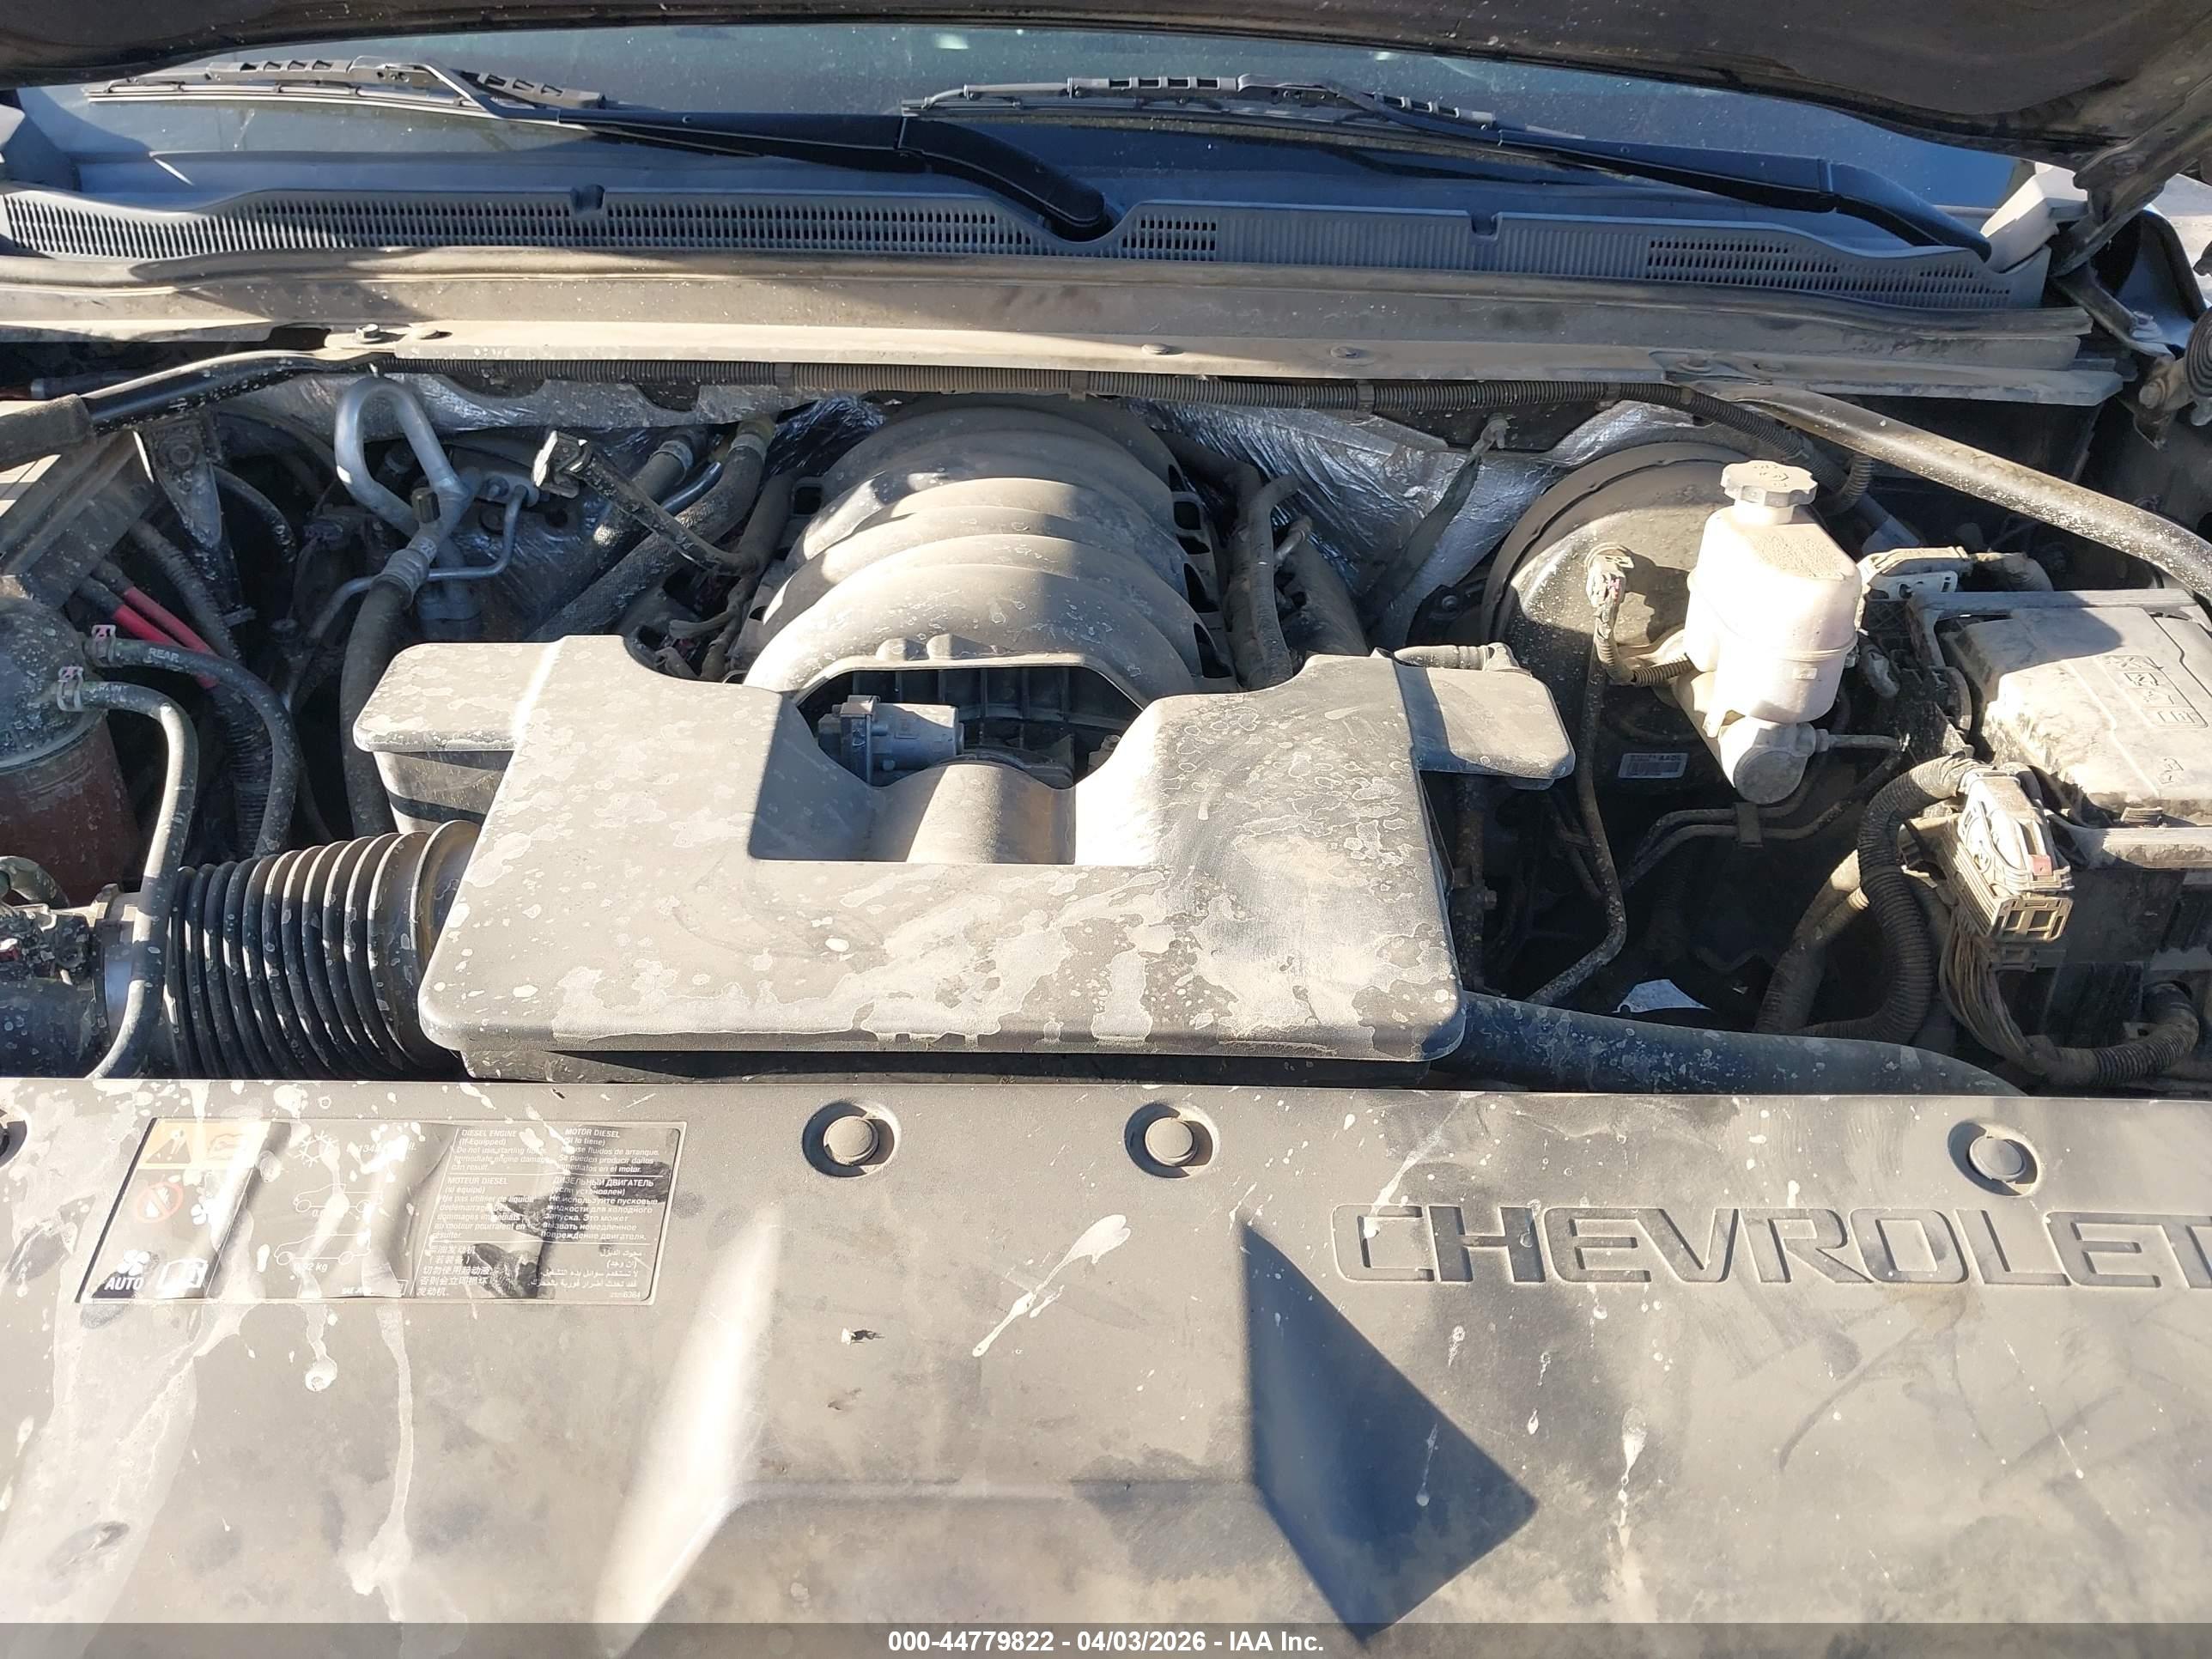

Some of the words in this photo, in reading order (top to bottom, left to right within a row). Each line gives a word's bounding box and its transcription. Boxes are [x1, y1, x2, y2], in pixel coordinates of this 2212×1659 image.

[148, 647, 179, 662] REAR
[593, 1129, 621, 1139] DIESEL
[447, 1176, 481, 1185] MOTEUR
[481, 1176, 509, 1185] DIESEL
[605, 1178, 654, 1188] ДВИГАТЕЛЬ
[1333, 1204, 2212, 1288] CHEVROLET
[315, 1262, 329, 1273] kg
[104, 1278, 144, 1291] AUTO
